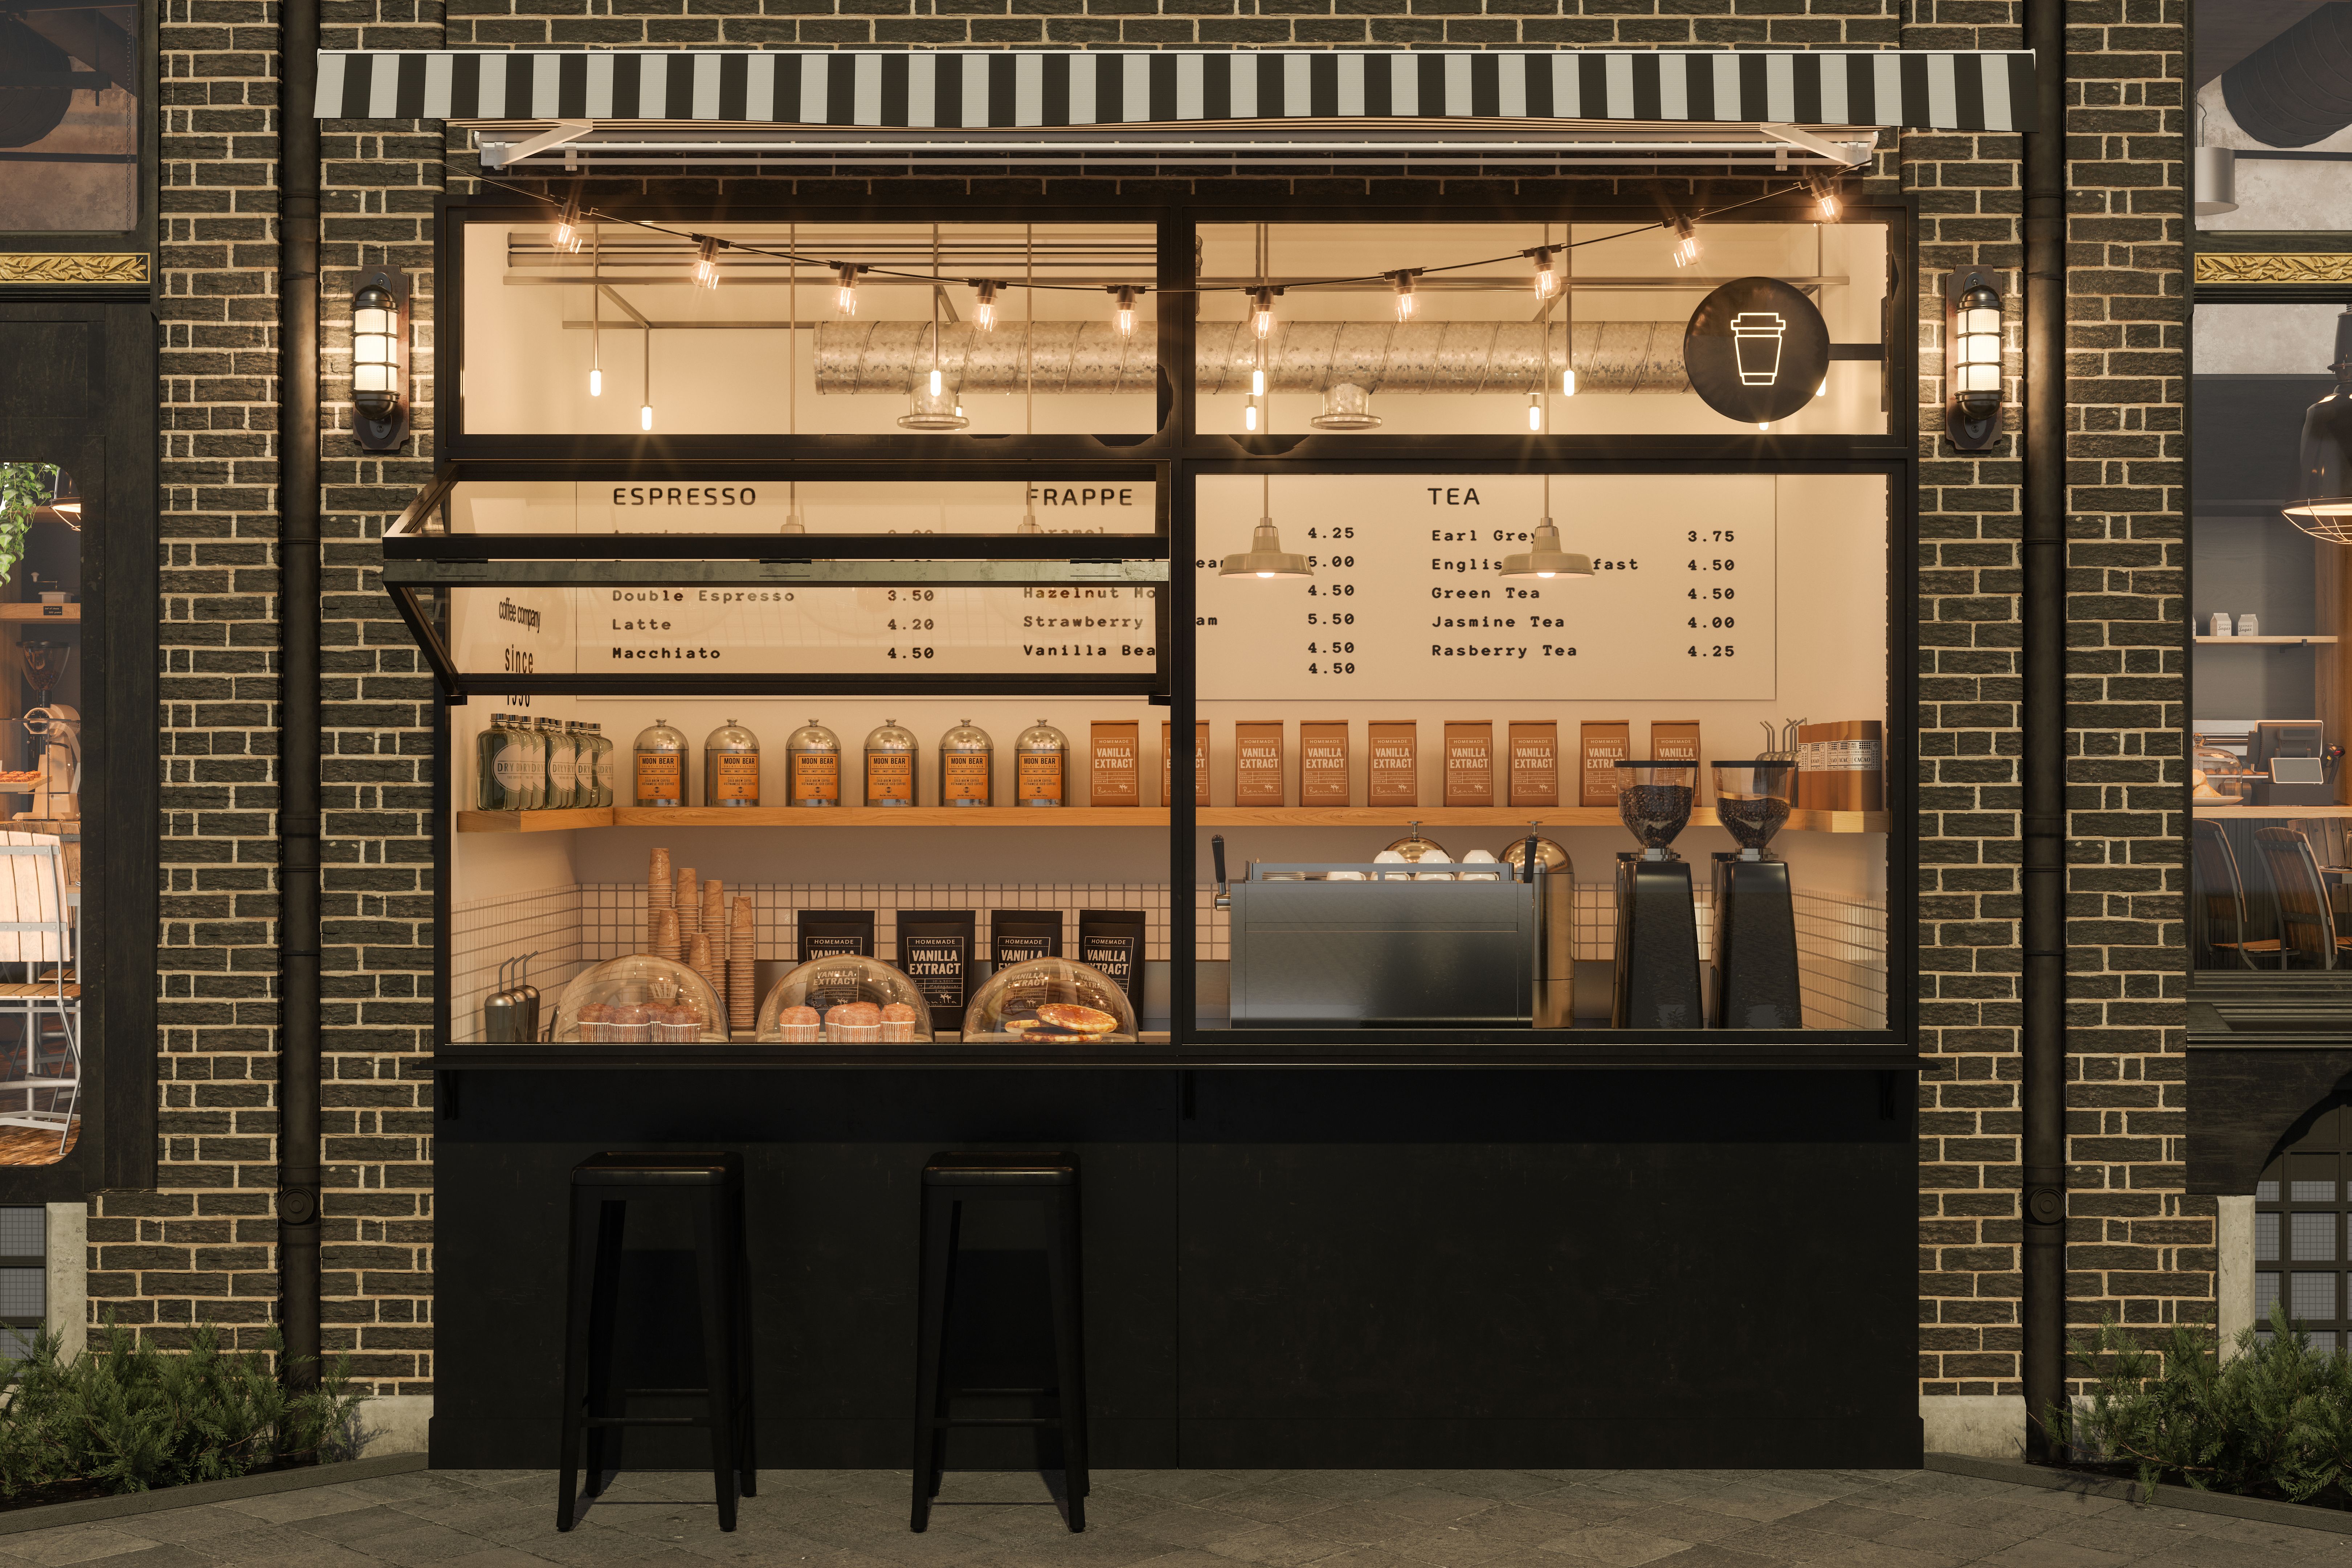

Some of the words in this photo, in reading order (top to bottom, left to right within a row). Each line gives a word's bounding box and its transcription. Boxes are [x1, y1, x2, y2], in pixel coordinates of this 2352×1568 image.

[614, 488, 755, 505] ESPRESSO
[1026, 488, 1133, 506] FRAPPE
[1428, 488, 1479, 505] TEA
[1308, 527, 1353, 538] 4.25
[1433, 530, 1477, 541] Earl
[1688, 531, 1734, 542] 3.75
[1308, 556, 1355, 568] 5.00
[1432, 559, 1502, 572] Englis
[1688, 560, 1734, 570] 4.50
[888, 590, 934, 601] 3.50
[1024, 587, 1119, 598] Hazelnut
[1308, 585, 1354, 596] 4.50
[1432, 587, 1490, 598] Green
[1506, 588, 1539, 598] Tea
[1688, 588, 1734, 599] 4.50
[613, 590, 683, 601] Double
[699, 590, 794, 604] Espresso
[499, 597, 516, 622] coffee
[517, 606, 540, 633] company
[1308, 613, 1354, 624] 5.50
[613, 619, 671, 630] Latte
[888, 619, 934, 630] 4.20
[1024, 616, 1142, 629] Strawberry
[1432, 616, 1515, 627] Jasmine
[1531, 616, 1564, 627] Tea
[1688, 617, 1734, 628] 4.00
[613, 648, 720, 658] Macchiato
[888, 648, 934, 658] 4.50
[1024, 645, 1106, 656] Vanilla
[1308, 642, 1354, 653] 4.50
[1433, 645, 1527, 658] Rasberry
[1543, 645, 1576, 656] Tea
[1688, 646, 1734, 657] 4.25
[505, 644, 533, 673] since
[1309, 663, 1355, 674] 4.50
[1097, 748, 1130, 757] VANILLA
[1242, 748, 1275, 757] VANILLA
[1307, 748, 1342, 757] VANILLA
[1376, 748, 1409, 757] VANILLA
[1452, 748, 1485, 757] VANILLA
[1516, 748, 1550, 757] VANILLA
[1589, 748, 1622, 757] VANILLA
[1659, 748, 1694, 757] VANILLA
[498, 763, 514, 772] DRY
[1095, 759, 1133, 768] EXTRACT
[1240, 759, 1278, 768] EXTRACT
[1306, 759, 1344, 768] EXTRACT
[1373, 759, 1412, 768] EXTRACT
[1450, 759, 1488, 768] EXTRACT
[1514, 759, 1553, 768] EXTRACT
[1587, 759, 1614, 768] EXTRA
[912, 950, 957, 961] VANILLA
[1001, 950, 1042, 961] VANILLA
[1088, 950, 1126, 961] VANILLA
[909, 963, 961, 974] EXTRACT
[1089, 963, 1128, 975] XTRACT
[1008, 979, 1045, 988] EXTRACT
